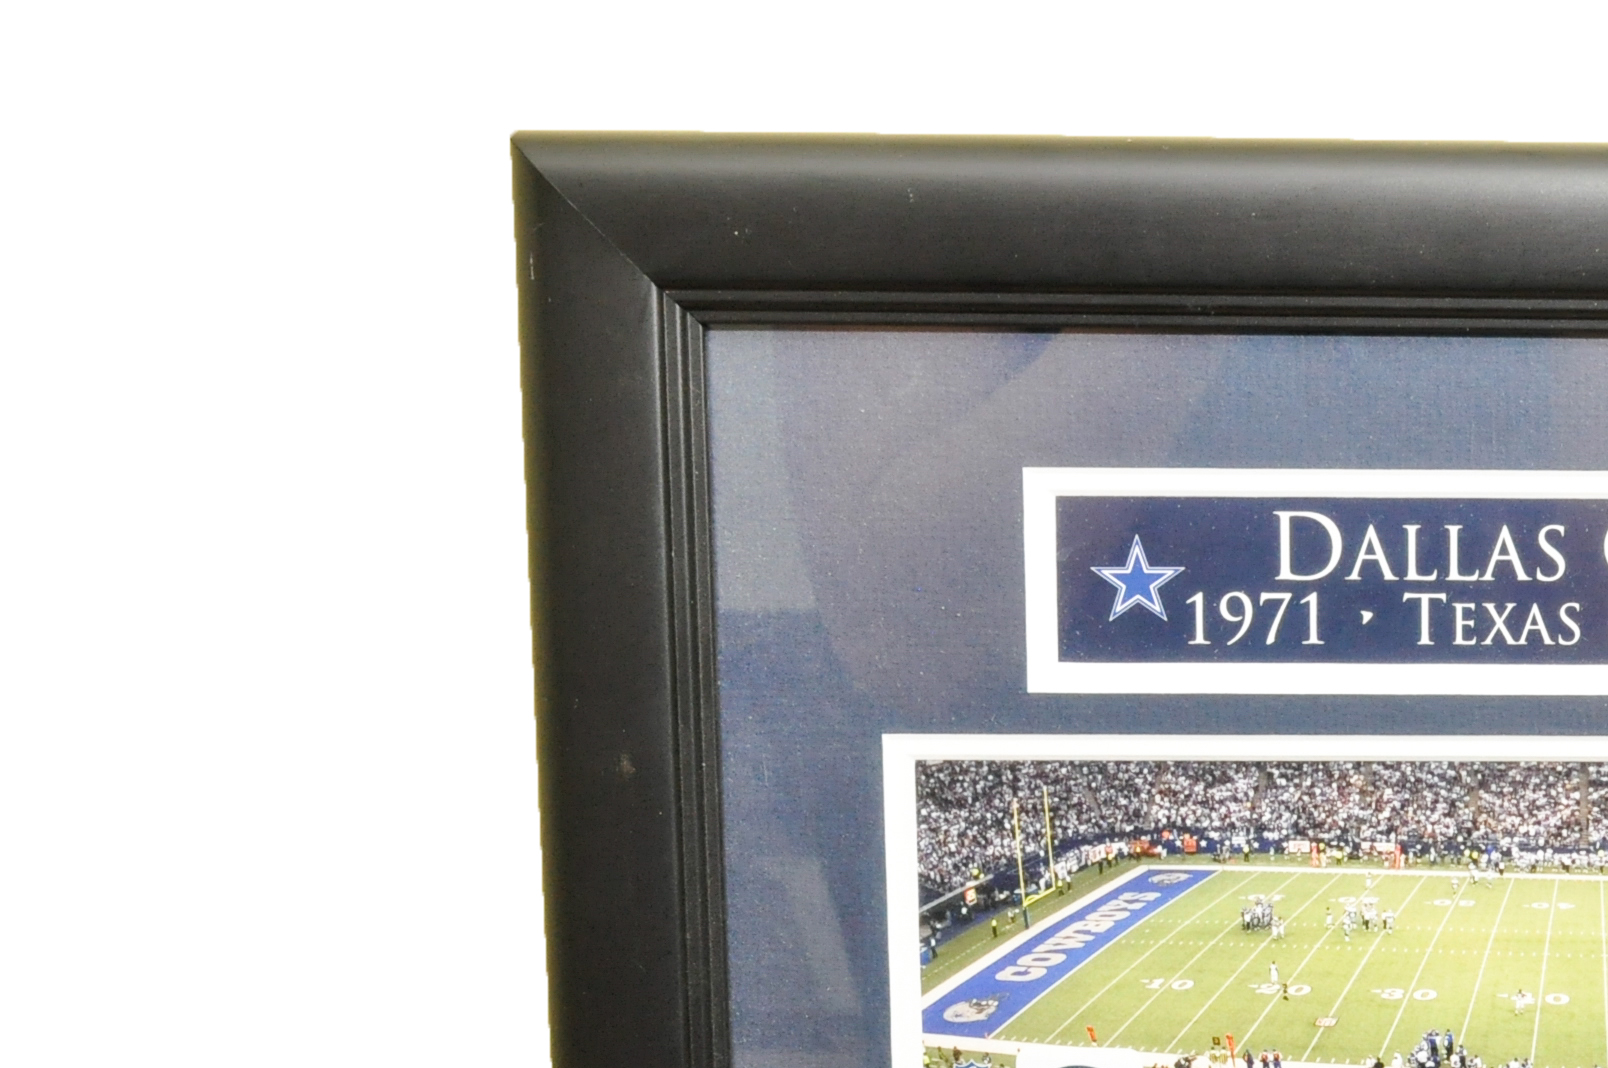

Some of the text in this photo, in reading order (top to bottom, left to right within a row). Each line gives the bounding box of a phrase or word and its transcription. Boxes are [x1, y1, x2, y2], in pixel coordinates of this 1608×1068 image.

[1272, 510, 1567, 582] DALLAS
[1186, 591, 1325, 646] 1971
[1402, 591, 1581, 646] TEXAS
[994, 891, 1162, 982] COWBOYS
